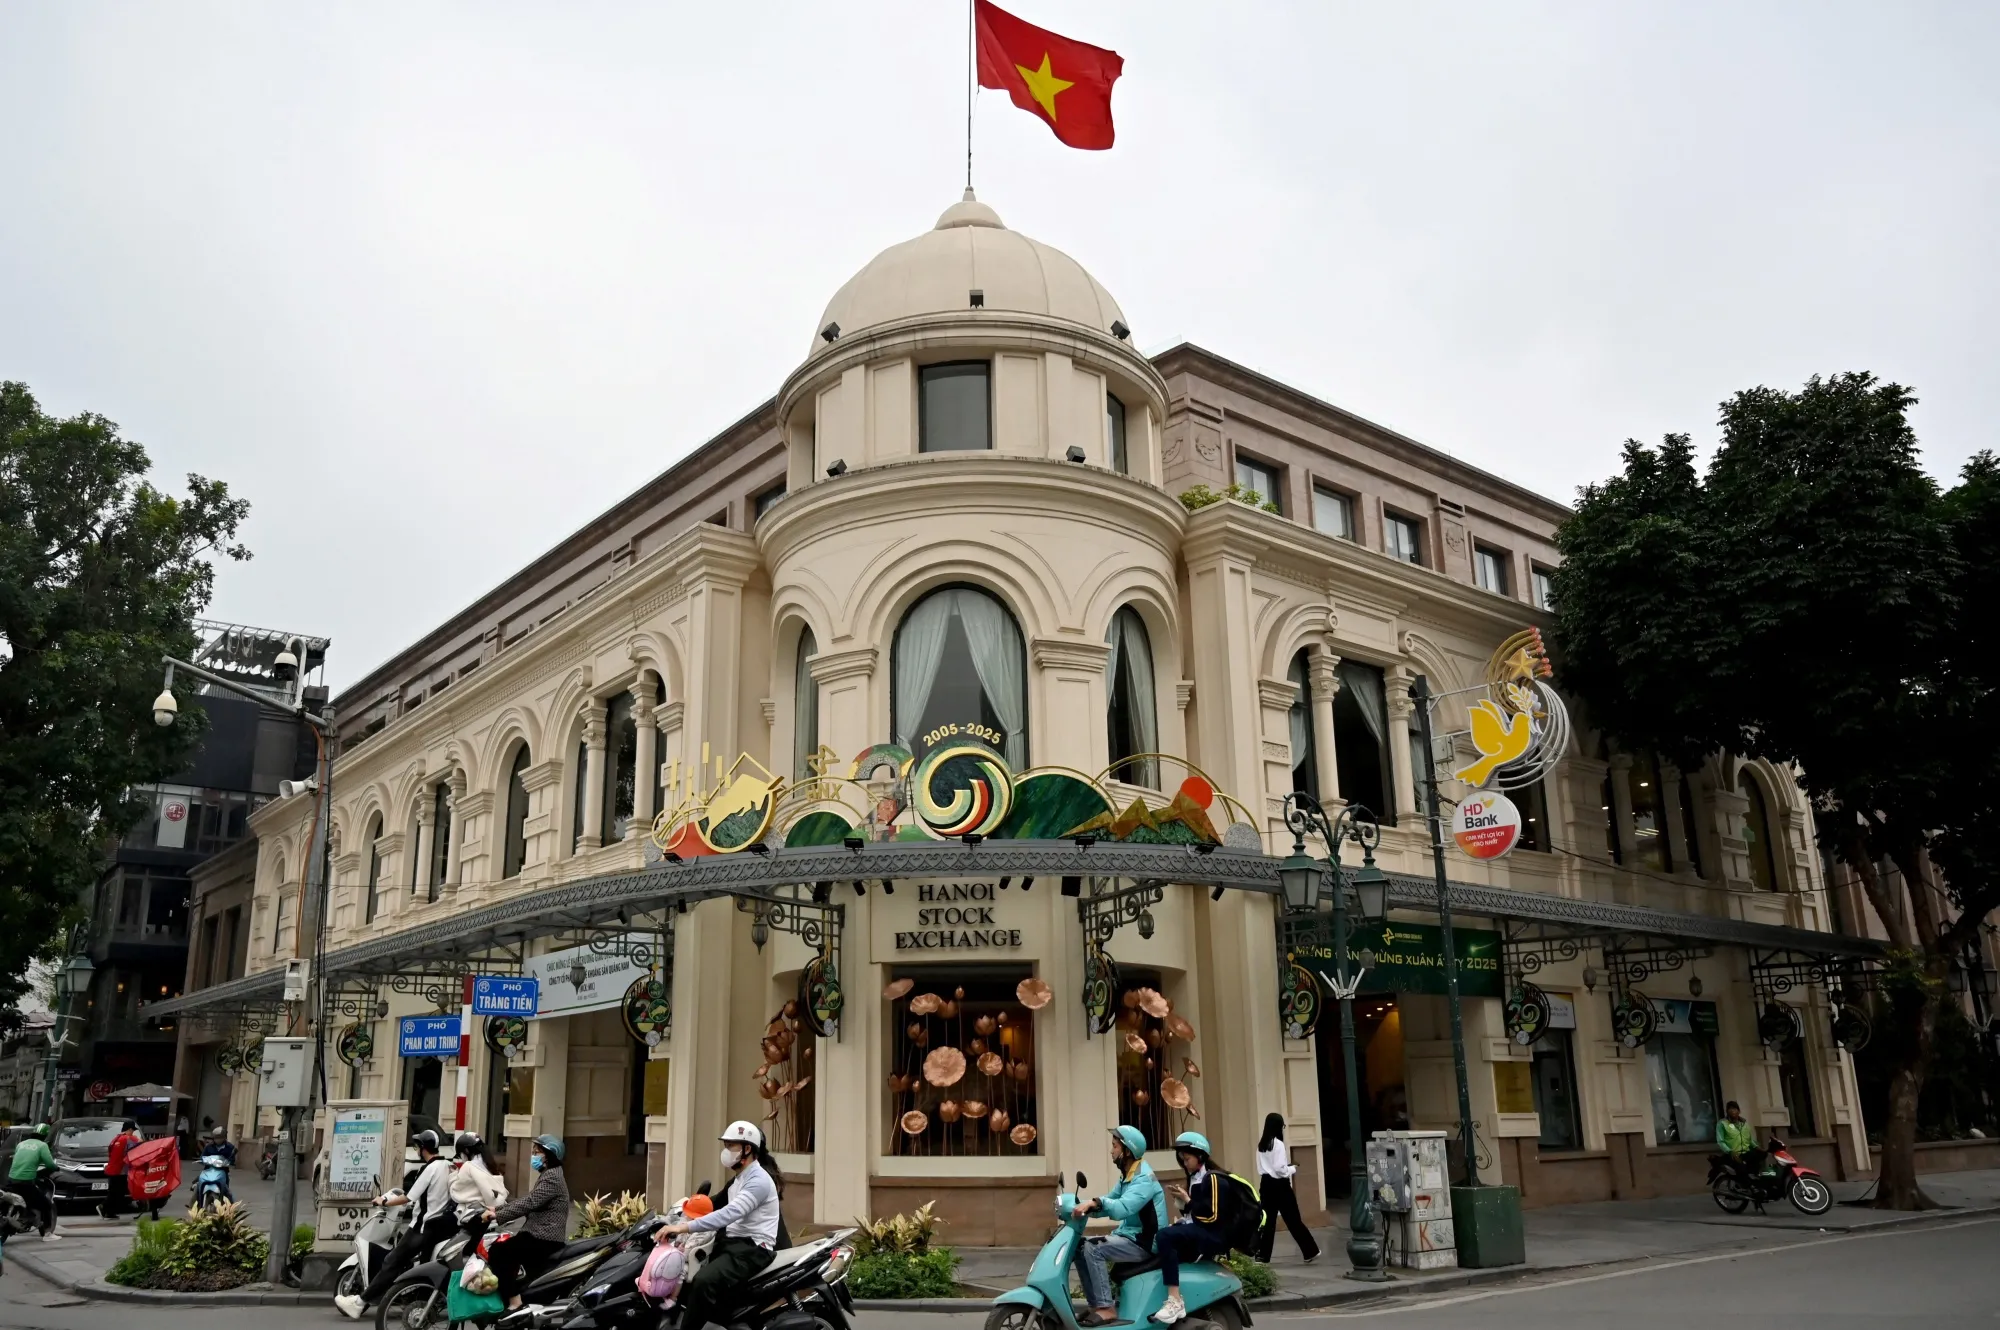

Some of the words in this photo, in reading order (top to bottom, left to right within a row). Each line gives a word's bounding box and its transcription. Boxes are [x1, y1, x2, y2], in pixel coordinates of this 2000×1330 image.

[923, 722, 1001, 747] 2005-2025
[1463, 803, 1483, 816] HD
[1464, 814, 1498, 829] Bank
[918, 883, 996, 901] HANOI
[918, 907, 996, 925] STOCK
[895, 929, 1023, 949] EXCHANGE
[1405, 953, 1434, 967] XUÂN
[1467, 957, 1498, 970] 2025
[503, 980, 522, 991] PHỐ
[480, 993, 510, 1010] TRÀNG
[512, 993, 533, 1011] TIỀN
[428, 1020, 447, 1030] PHỐ
[404, 1037, 422, 1050] PHAN
[424, 1036, 437, 1050] CHU
[439, 1036, 458, 1049] TRINH
